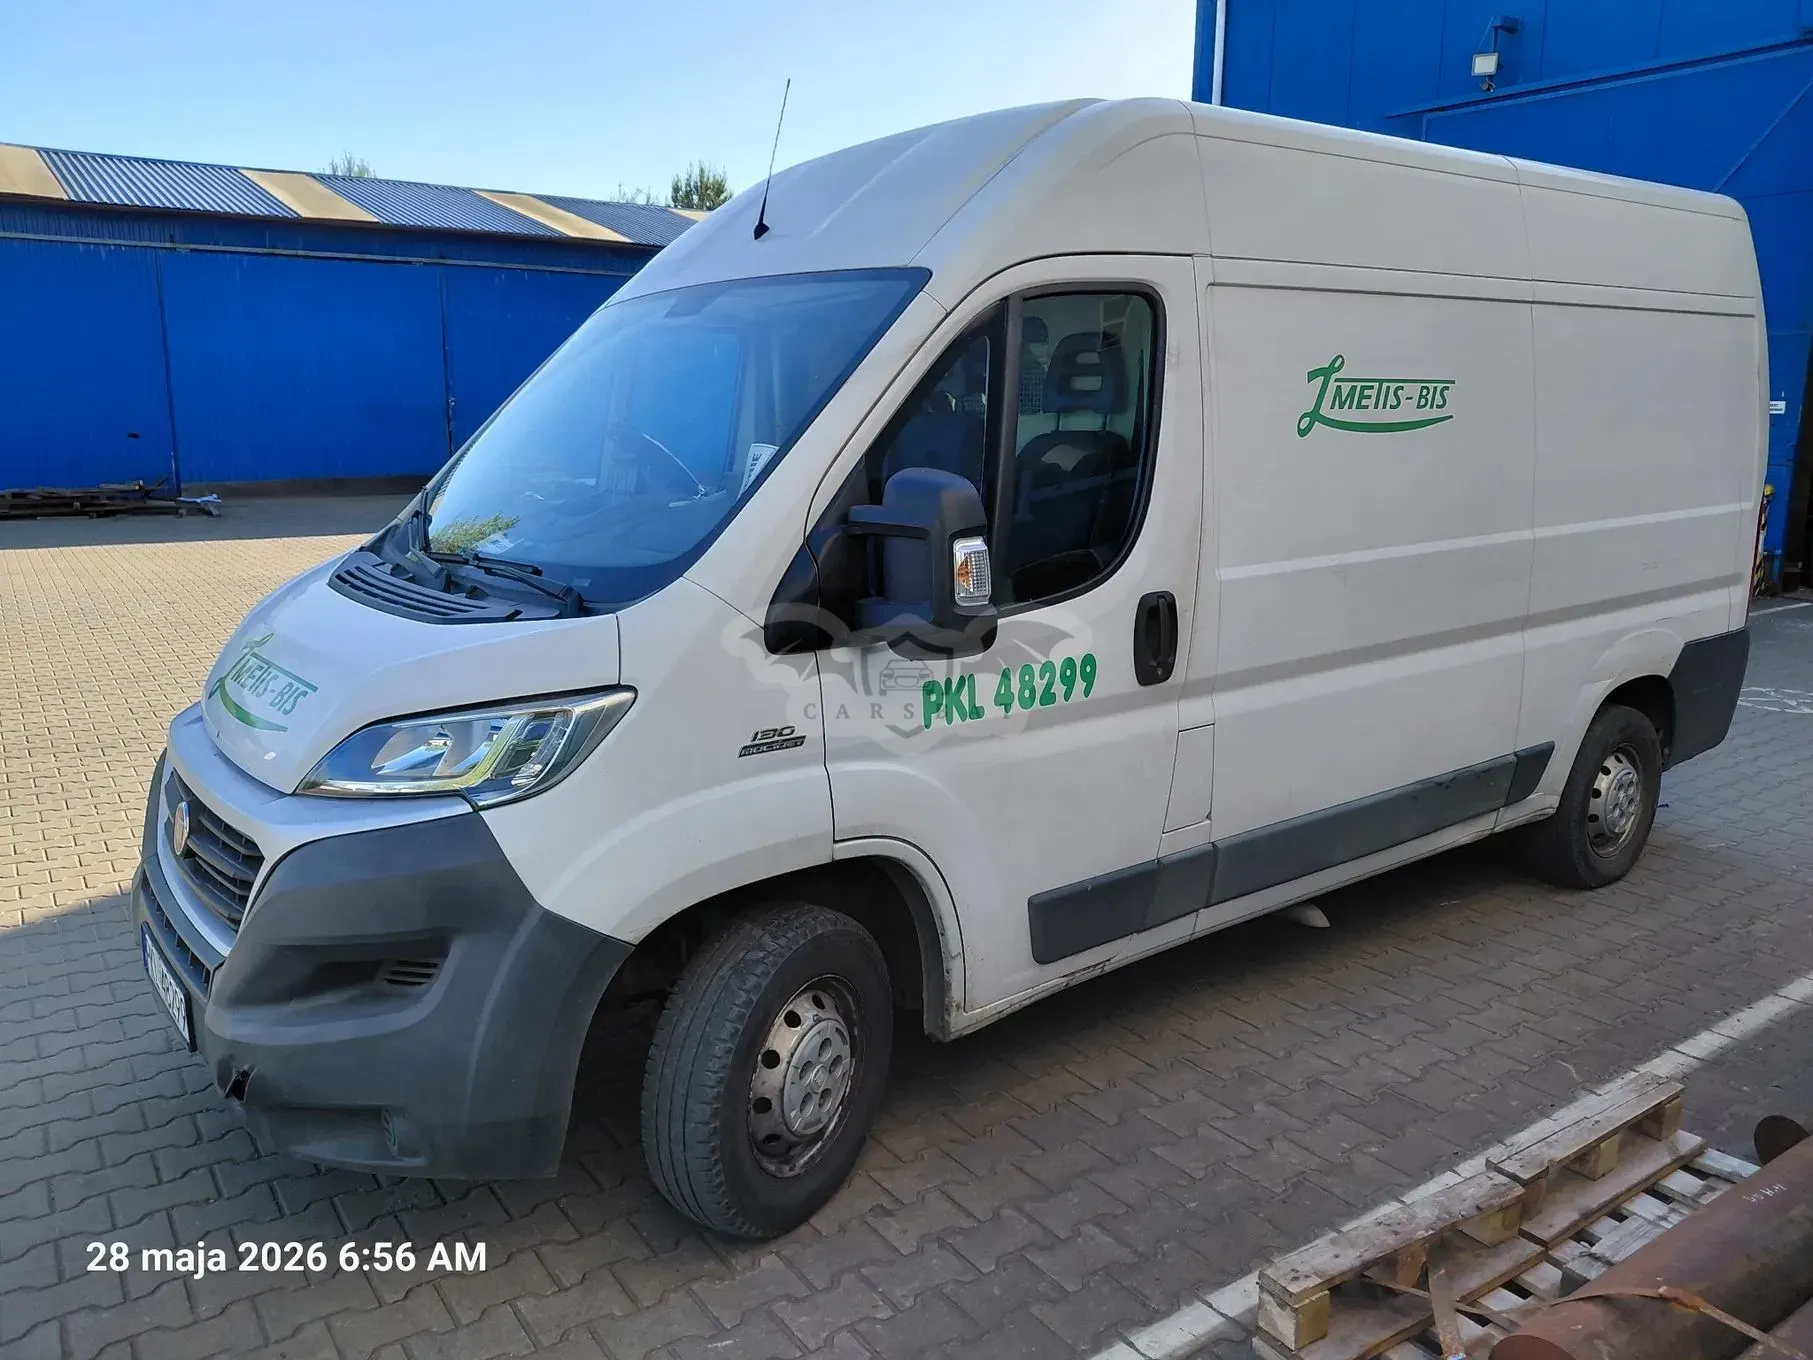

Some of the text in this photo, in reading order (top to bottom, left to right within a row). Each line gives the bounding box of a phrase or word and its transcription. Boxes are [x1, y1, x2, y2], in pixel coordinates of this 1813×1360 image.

[921, 652, 1098, 730] PKL 48299
[751, 725, 796, 742] 130
